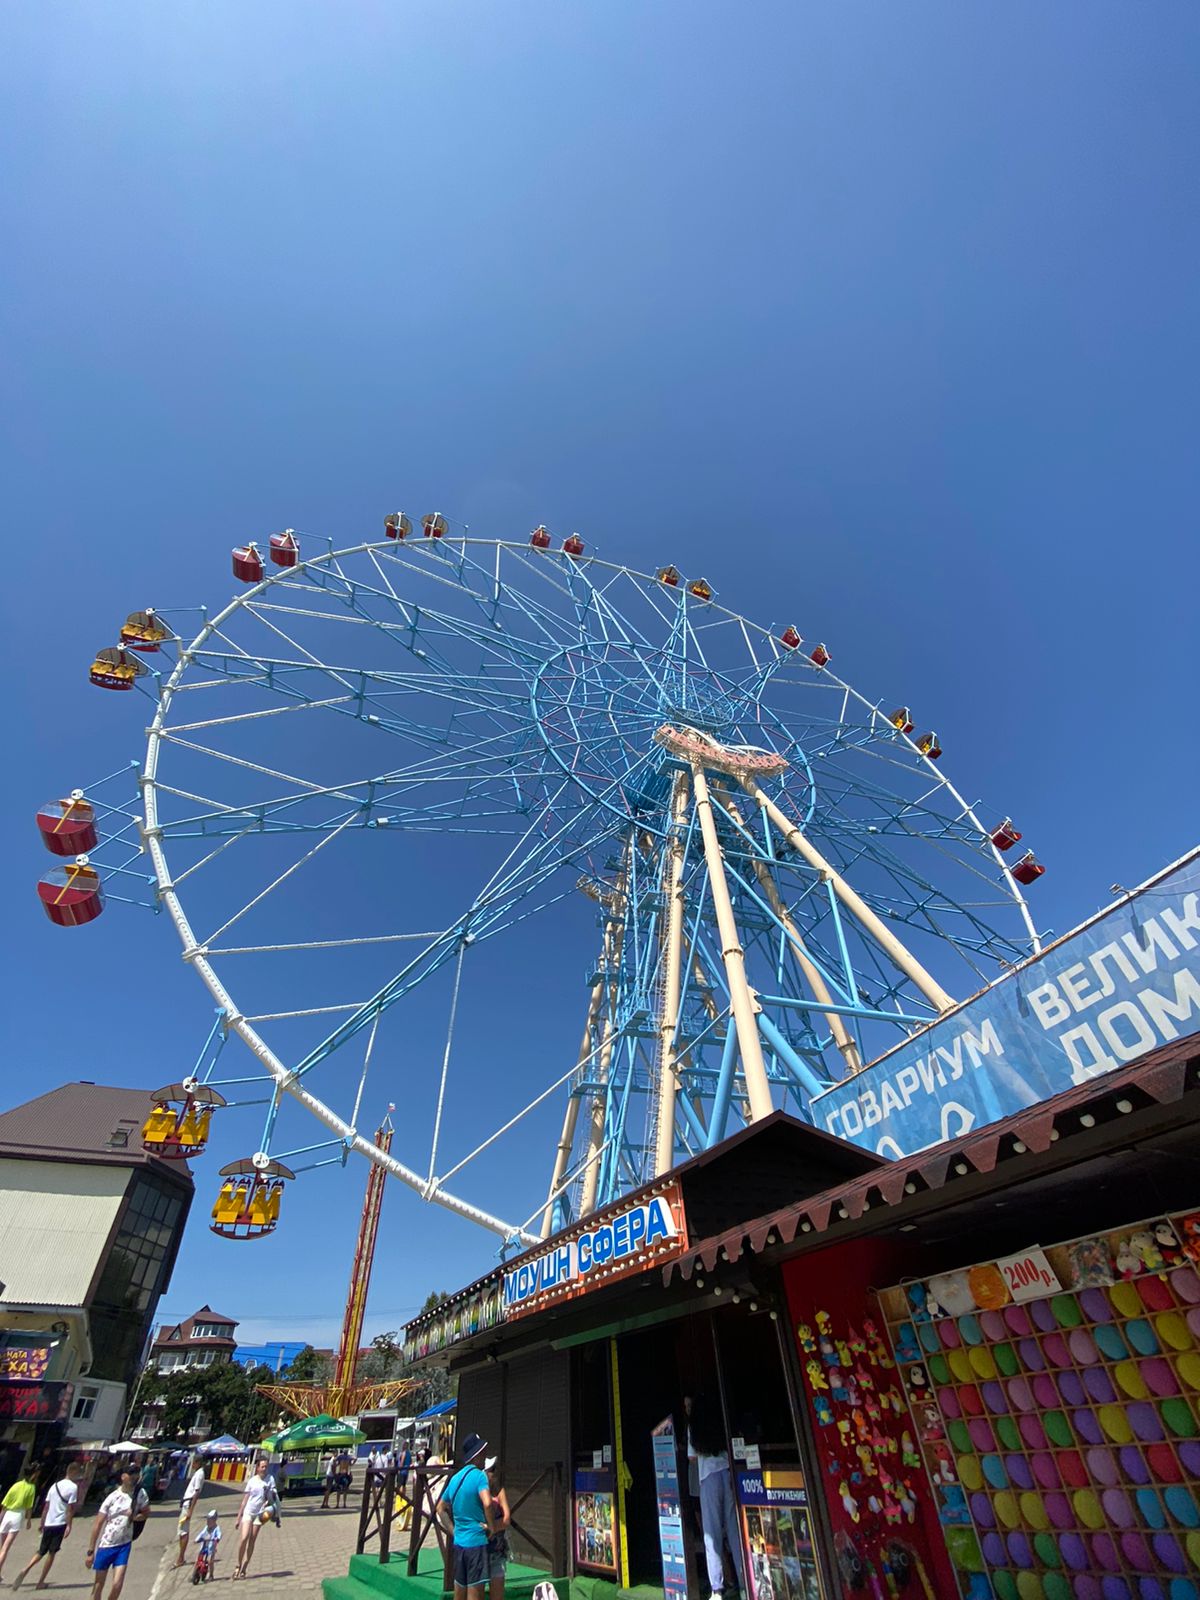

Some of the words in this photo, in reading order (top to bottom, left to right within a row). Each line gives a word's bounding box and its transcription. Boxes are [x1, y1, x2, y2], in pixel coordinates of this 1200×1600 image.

[1059, 968, 1200, 1086] ДОМ
[503, 1243, 575, 1304] МОУШН
[577, 1198, 672, 1274] СФЕРА
[742, 1479, 763, 1494] 100%
